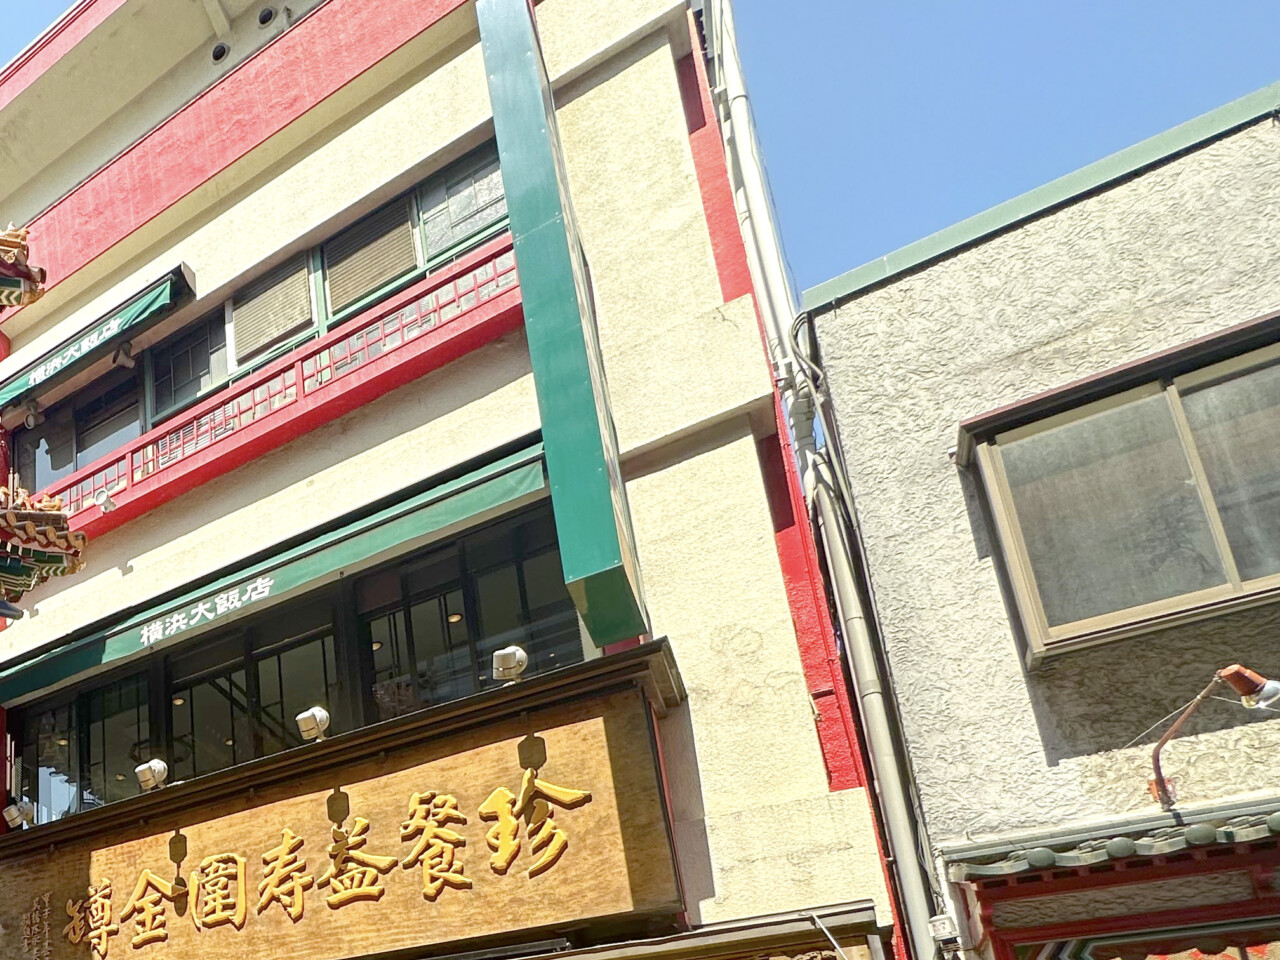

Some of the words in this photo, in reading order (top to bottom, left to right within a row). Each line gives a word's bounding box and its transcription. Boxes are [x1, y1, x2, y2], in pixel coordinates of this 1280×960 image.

[27, 317, 122, 387] 横浜大飯店
[139, 577, 275, 648] 横浜大飯店
